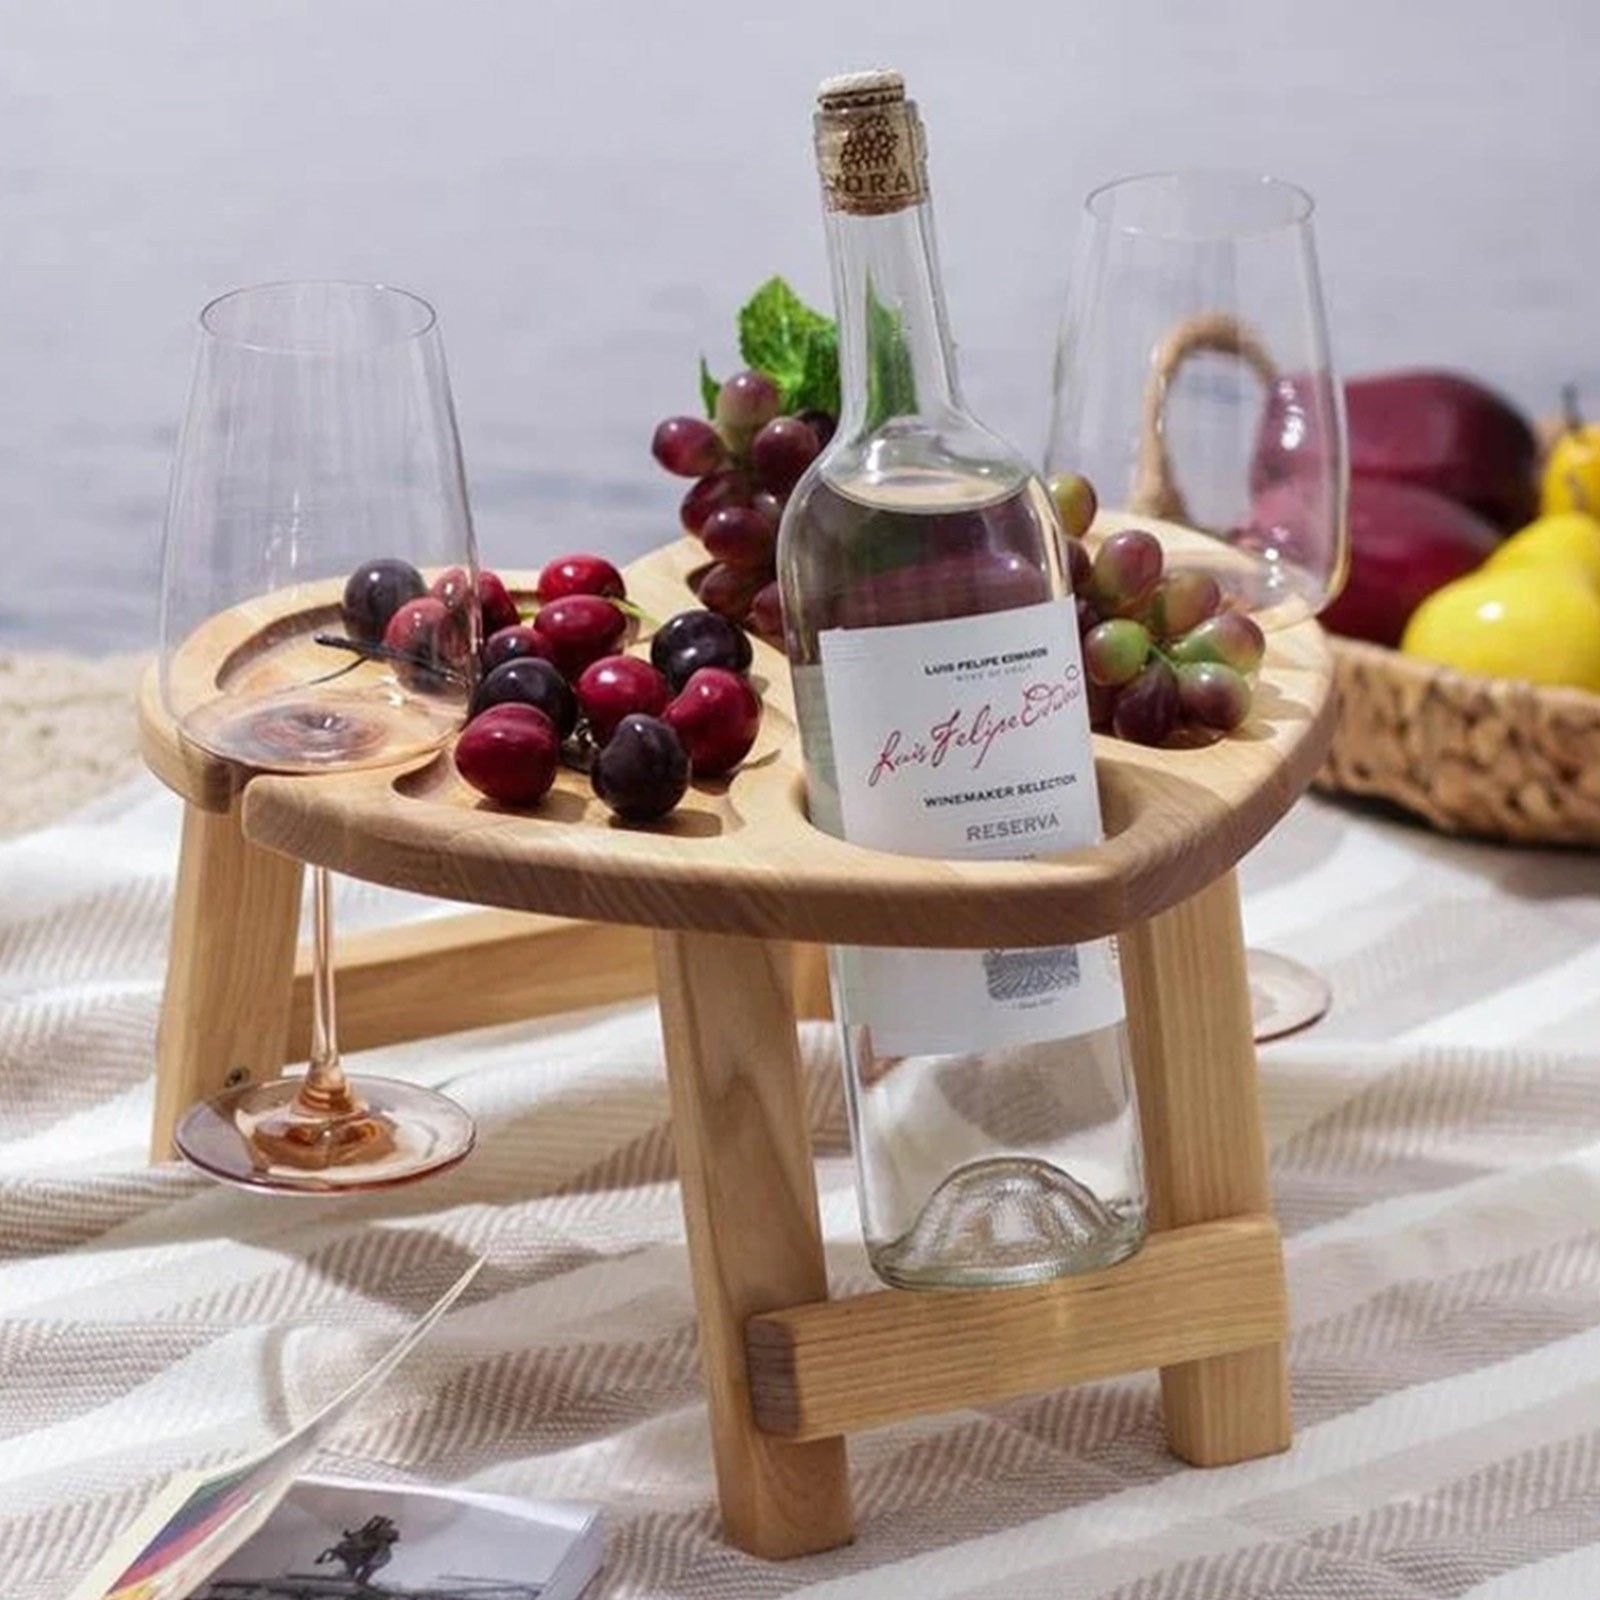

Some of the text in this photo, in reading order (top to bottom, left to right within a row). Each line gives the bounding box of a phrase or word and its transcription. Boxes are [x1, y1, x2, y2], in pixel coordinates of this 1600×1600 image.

[924, 664, 955, 676] LUIS
[957, 656, 1000, 671] FELIPE
[868, 730, 930, 787] Luis
[930, 704, 1018, 769] Felipe
[923, 773, 1078, 807] WINEMAKER SELECTION
[966, 812, 1060, 841] RESERVA
